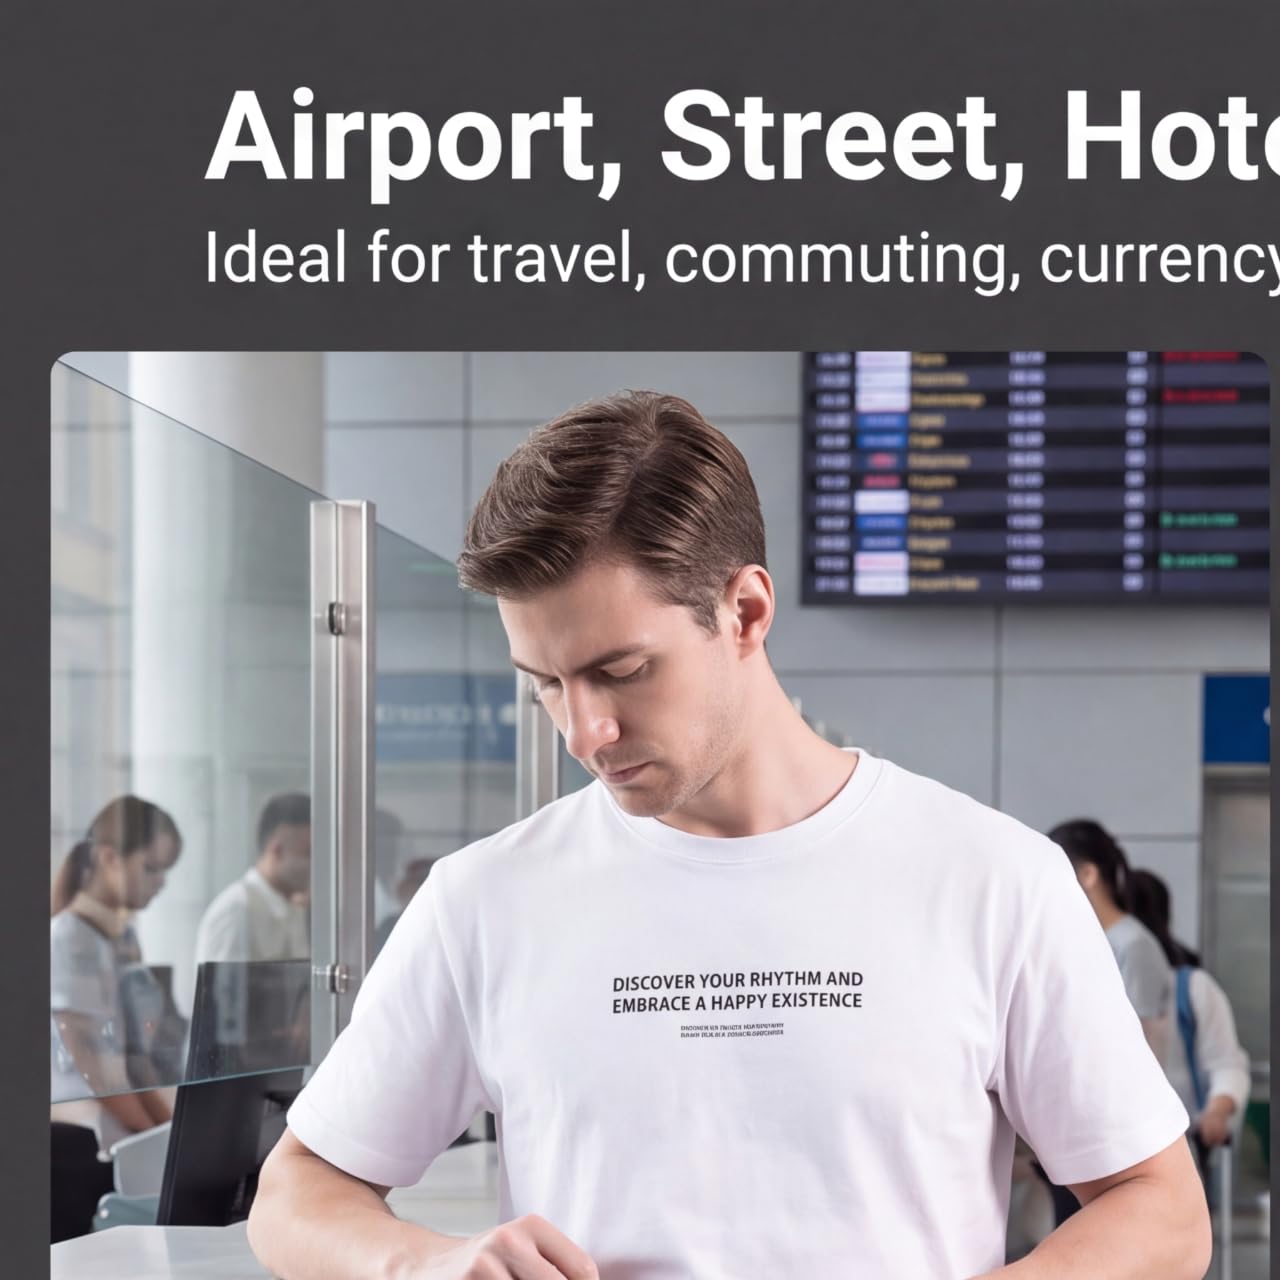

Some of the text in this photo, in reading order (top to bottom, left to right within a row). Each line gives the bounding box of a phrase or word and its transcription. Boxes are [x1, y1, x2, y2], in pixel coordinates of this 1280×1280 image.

[612, 971, 864, 992] DISCOVER YOUR RHYTHM AND
[612, 992, 863, 1014] EMBRACE A HAPPY EXISTENCE
